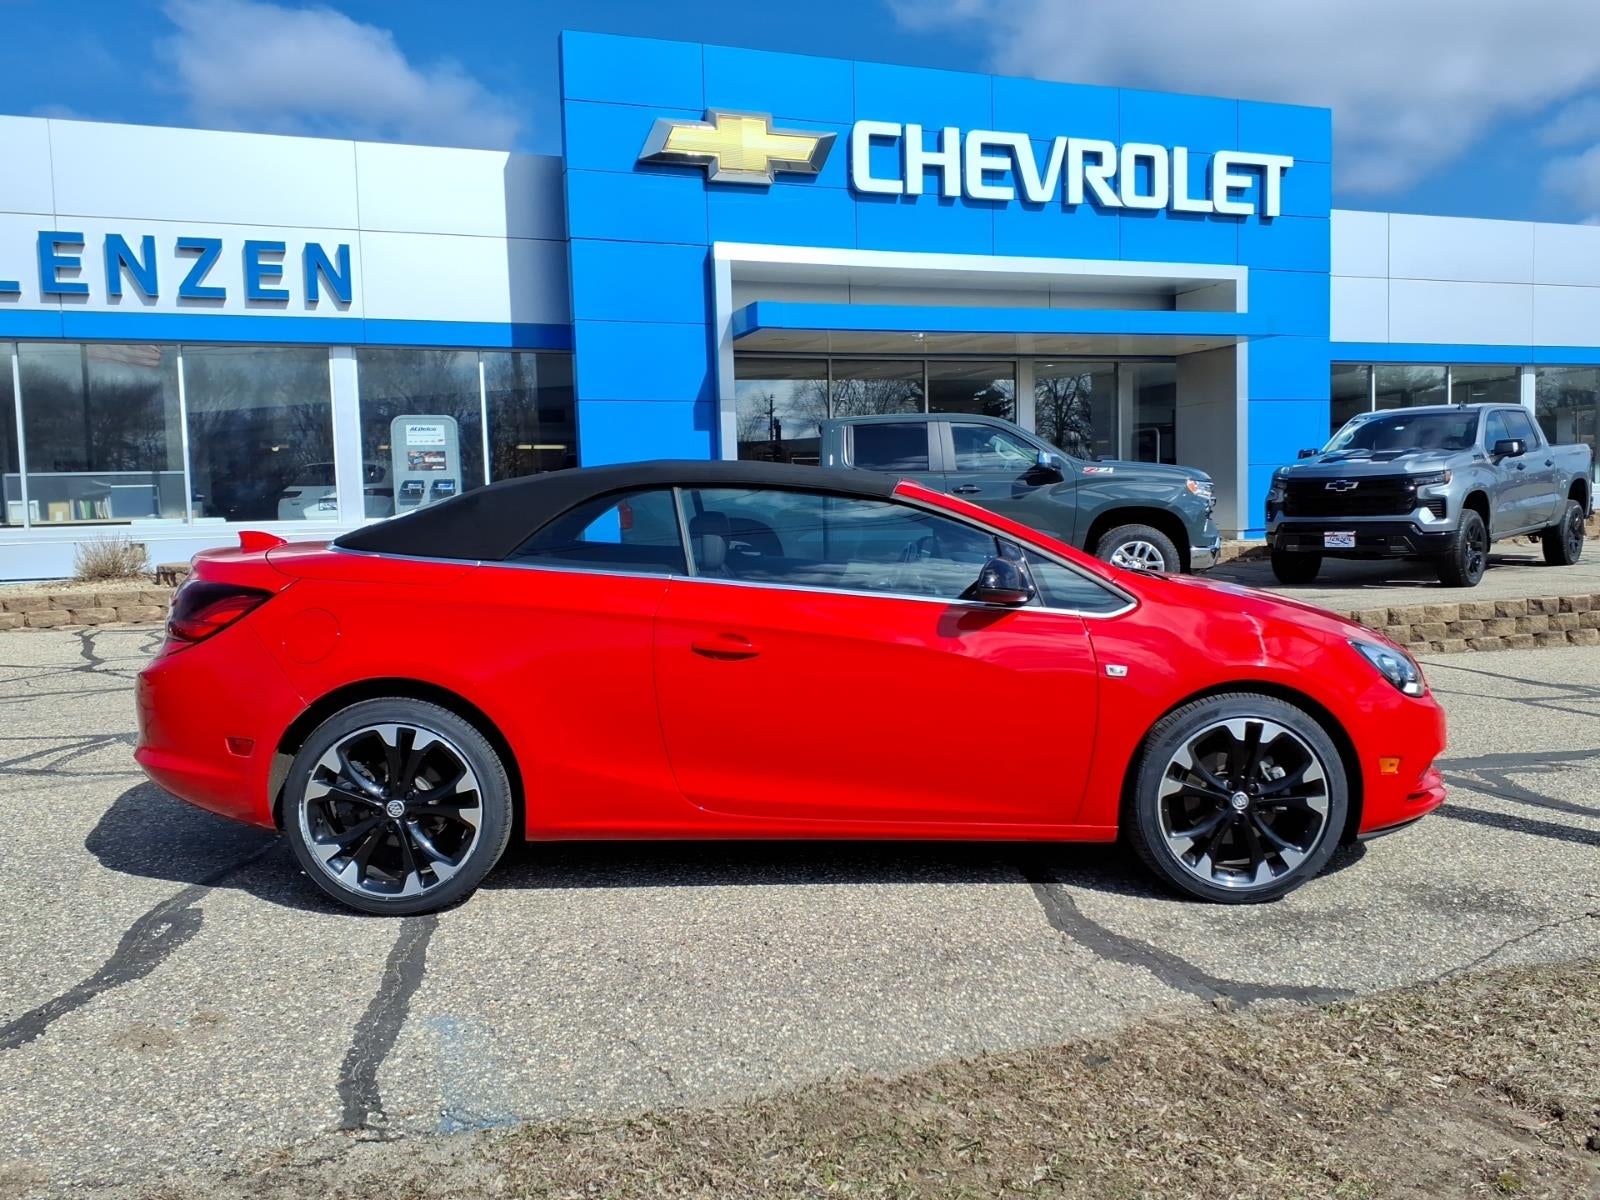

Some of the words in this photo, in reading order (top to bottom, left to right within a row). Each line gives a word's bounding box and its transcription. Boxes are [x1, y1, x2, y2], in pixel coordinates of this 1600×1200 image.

[852, 120, 1294, 217] CHEVROLET
[0, 230, 352, 303] ENZEN
[1082, 466, 1114, 474] Z71
